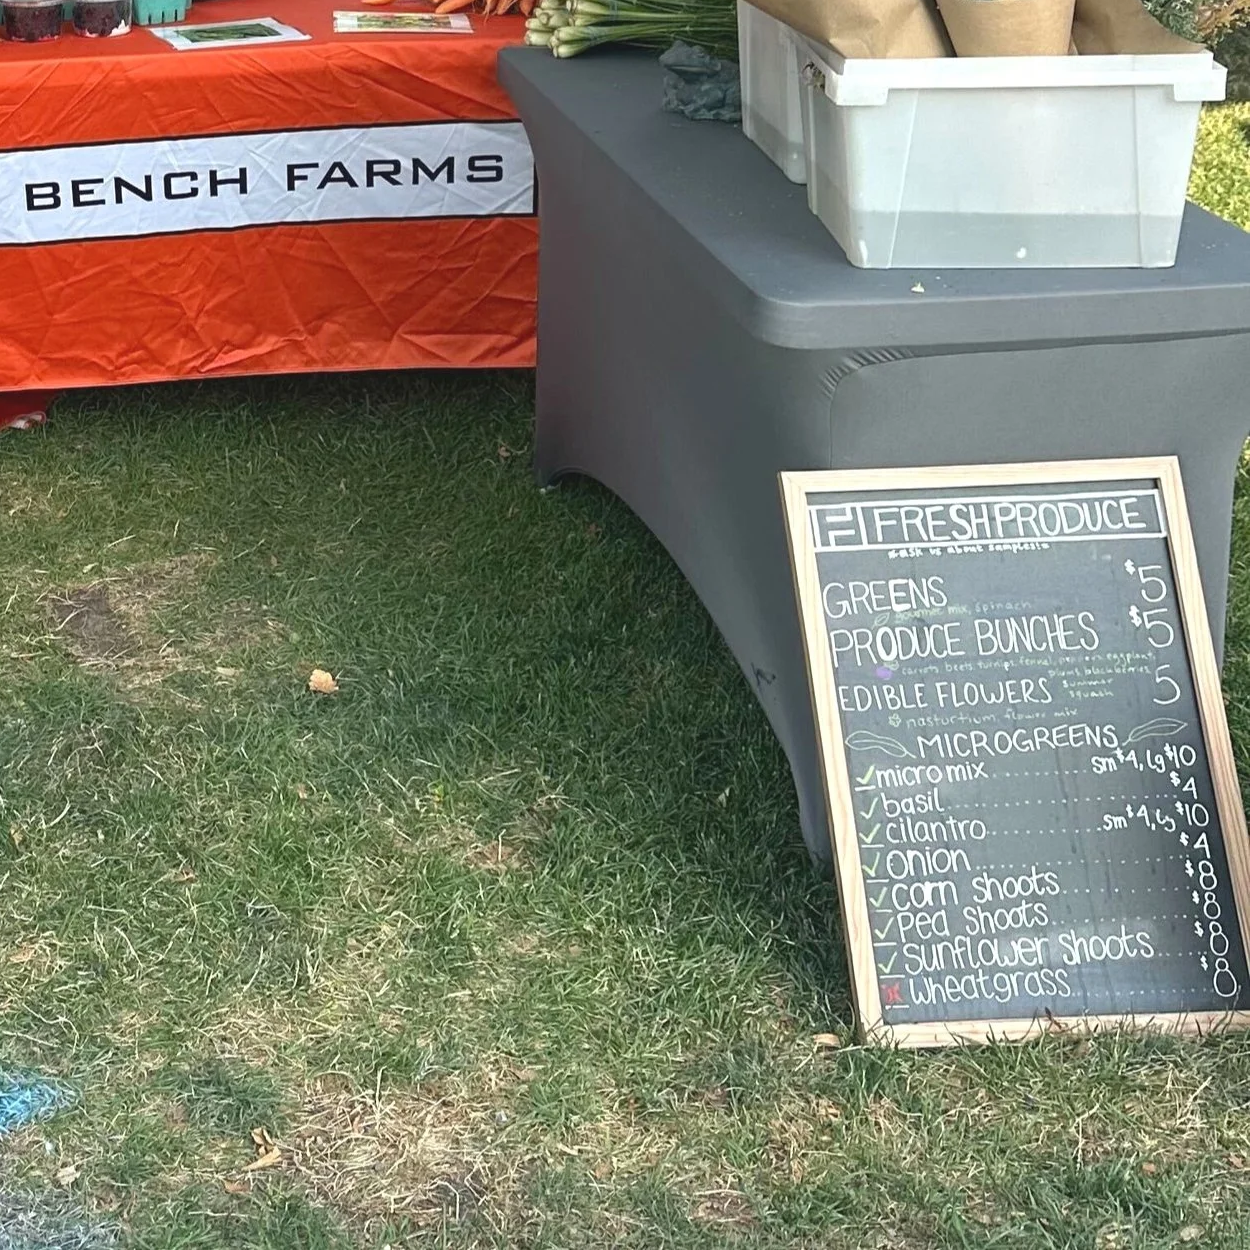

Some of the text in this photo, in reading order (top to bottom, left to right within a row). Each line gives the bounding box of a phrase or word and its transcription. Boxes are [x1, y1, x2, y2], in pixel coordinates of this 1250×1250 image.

[24, 166, 249, 213] BENCH
[286, 154, 505, 192] FARMS
[873, 497, 1147, 543] FRESH PRODUCE
[822, 559, 1167, 618] GREENS $5
[831, 605, 1174, 668] PRODUCE BUNCHES $5
[838, 664, 1182, 713] EDIBLE FLOWERS 5
[917, 724, 1119, 760] MICROGREENS
[876, 762, 941, 789] micro
[942, 759, 988, 784] mix
[881, 771, 1198, 819] basil $4
[885, 816, 987, 843] cilantro
[1179, 832, 1210, 859] $4
[891, 860, 1217, 911] corn shoots $8
[1192, 890, 1221, 920] $8
[1194, 921, 1229, 957] $8
[1200, 954, 1237, 997] $8
